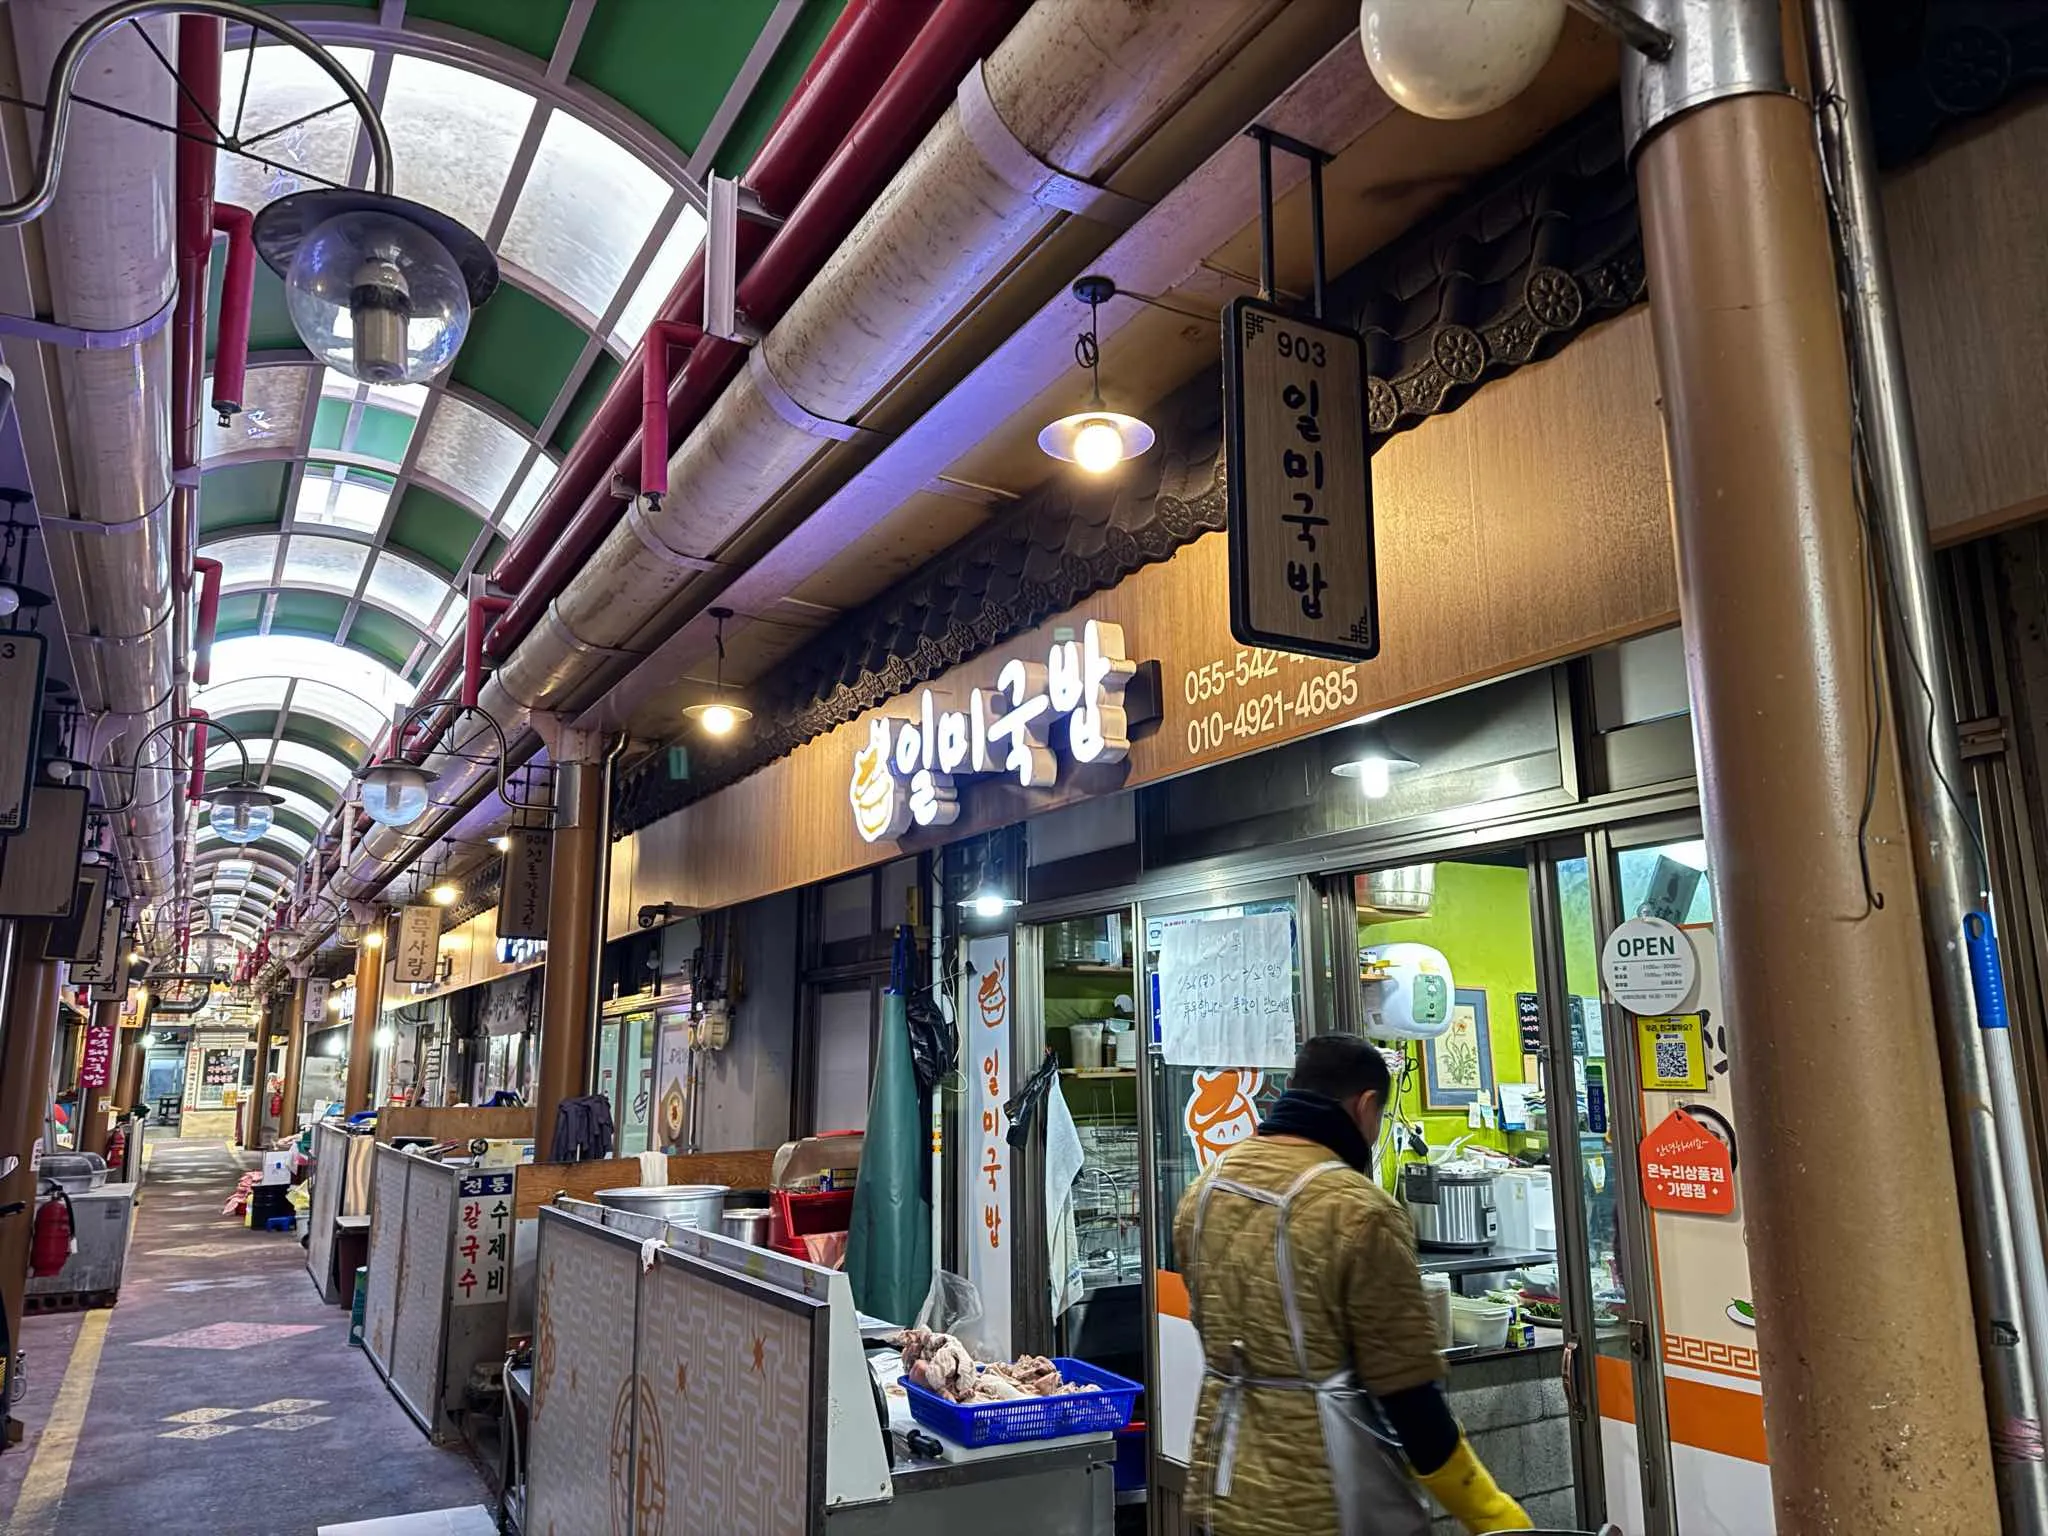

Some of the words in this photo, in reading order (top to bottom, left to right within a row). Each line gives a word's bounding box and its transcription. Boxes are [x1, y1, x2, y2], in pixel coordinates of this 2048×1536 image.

[1277, 331, 1327, 368] 903
[1281, 378, 1330, 620] 일미국밥
[1185, 647, 1318, 705] 055-542-
[1187, 664, 1359, 754] 010-4921-4685
[896, 619, 1128, 826] 일미국밥
[1617, 935, 1675, 958] OPEN
[464, 1176, 509, 1194] 전통
[983, 1047, 1002, 1249] 일미국밥
[1647, 1163, 1725, 1183] 온누리상품권
[1667, 1182, 1707, 1199] 가맹점
[458, 1201, 482, 1299] 칼국수
[486, 1200, 509, 1295] 수제비
